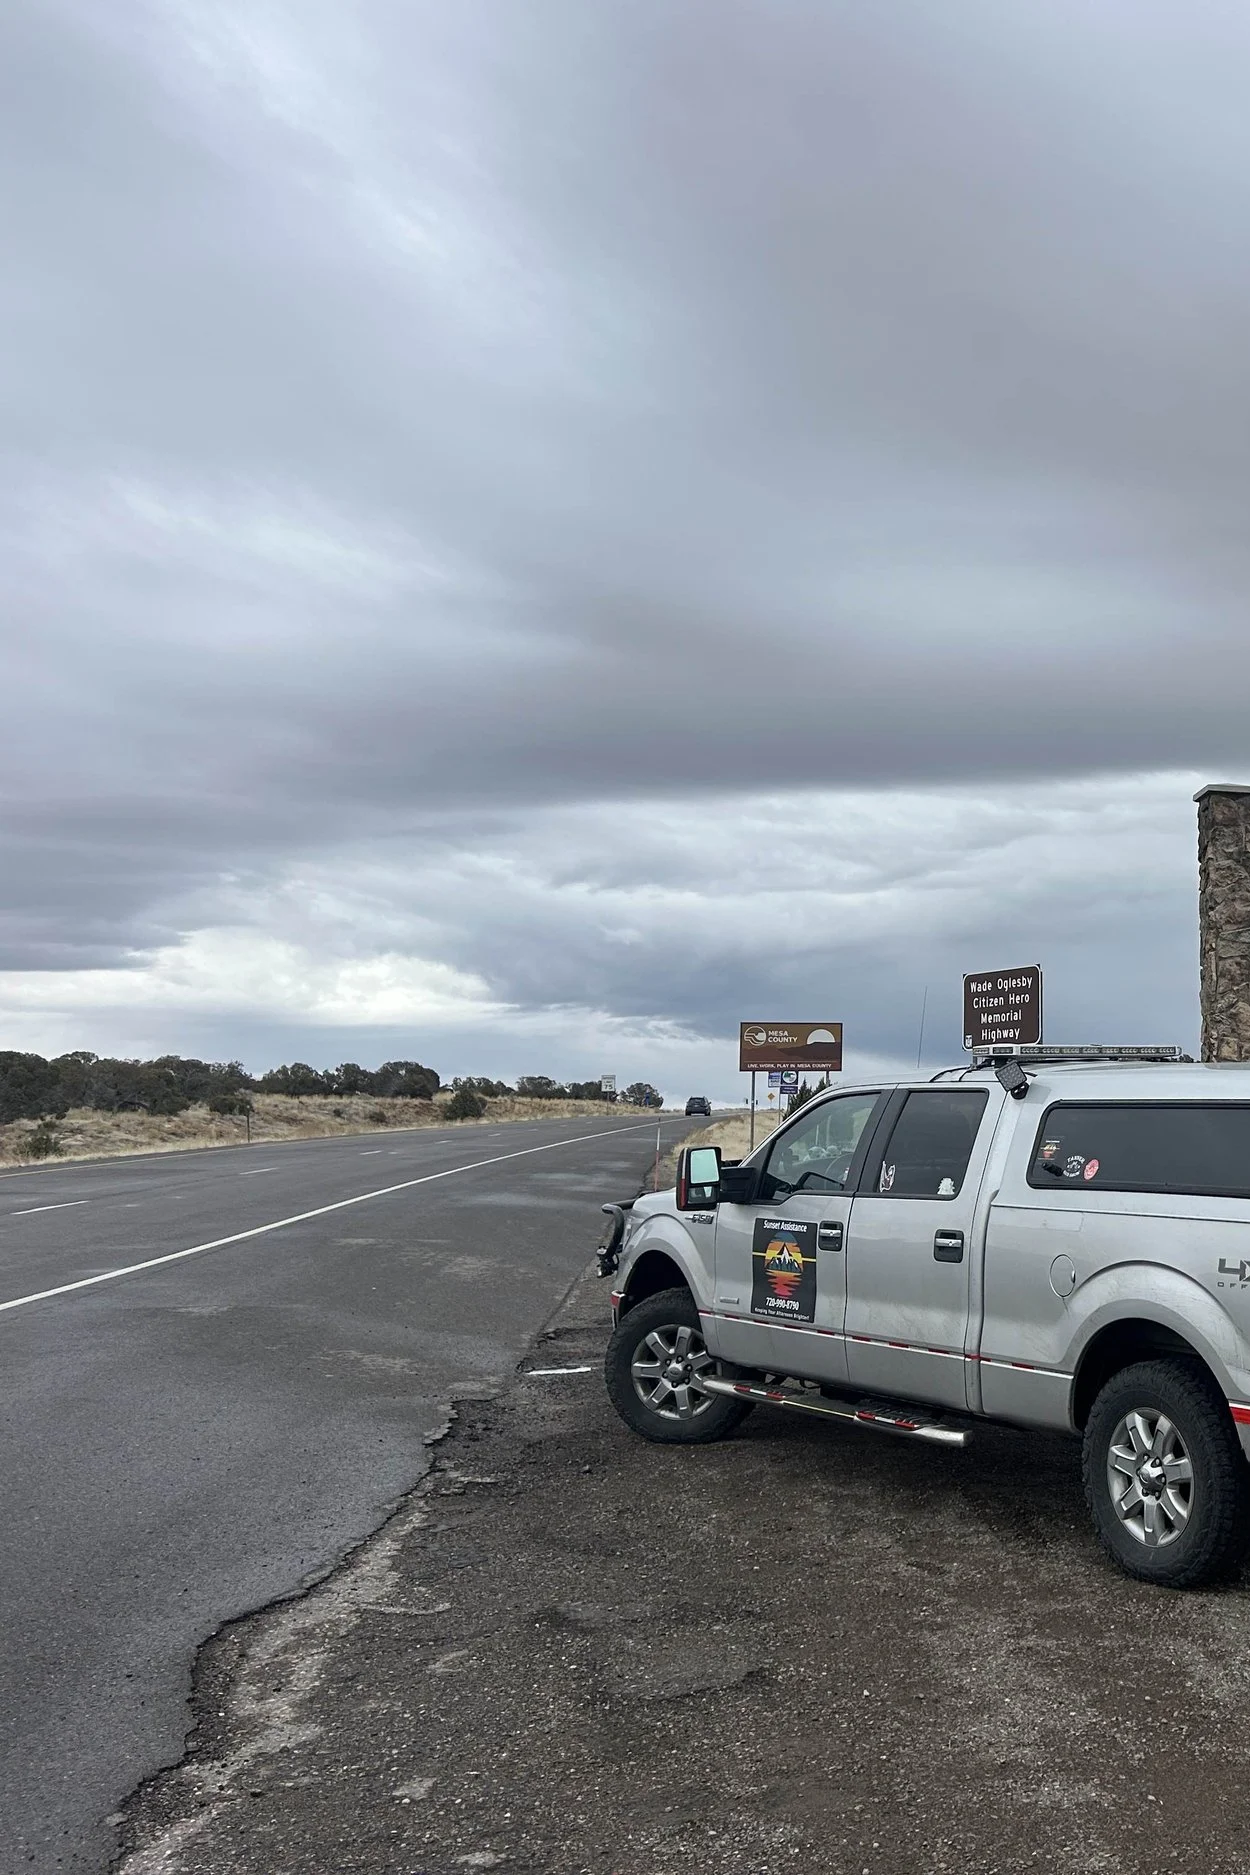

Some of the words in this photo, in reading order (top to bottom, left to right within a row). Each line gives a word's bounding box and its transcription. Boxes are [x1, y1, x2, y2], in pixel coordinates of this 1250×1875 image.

[970, 980, 993, 993] Wade
[997, 975, 1033, 991] Oglesby
[973, 995, 1004, 1009] Citizen
[1009, 993, 1030, 1005] Hero
[981, 1009, 1022, 1024] Memorial
[981, 1028, 1020, 1042] Highway
[763, 1219, 781, 1230] Sunset
[780, 1221, 808, 1233] Assistance
[765, 1296, 799, 1311] 720-990-8790
